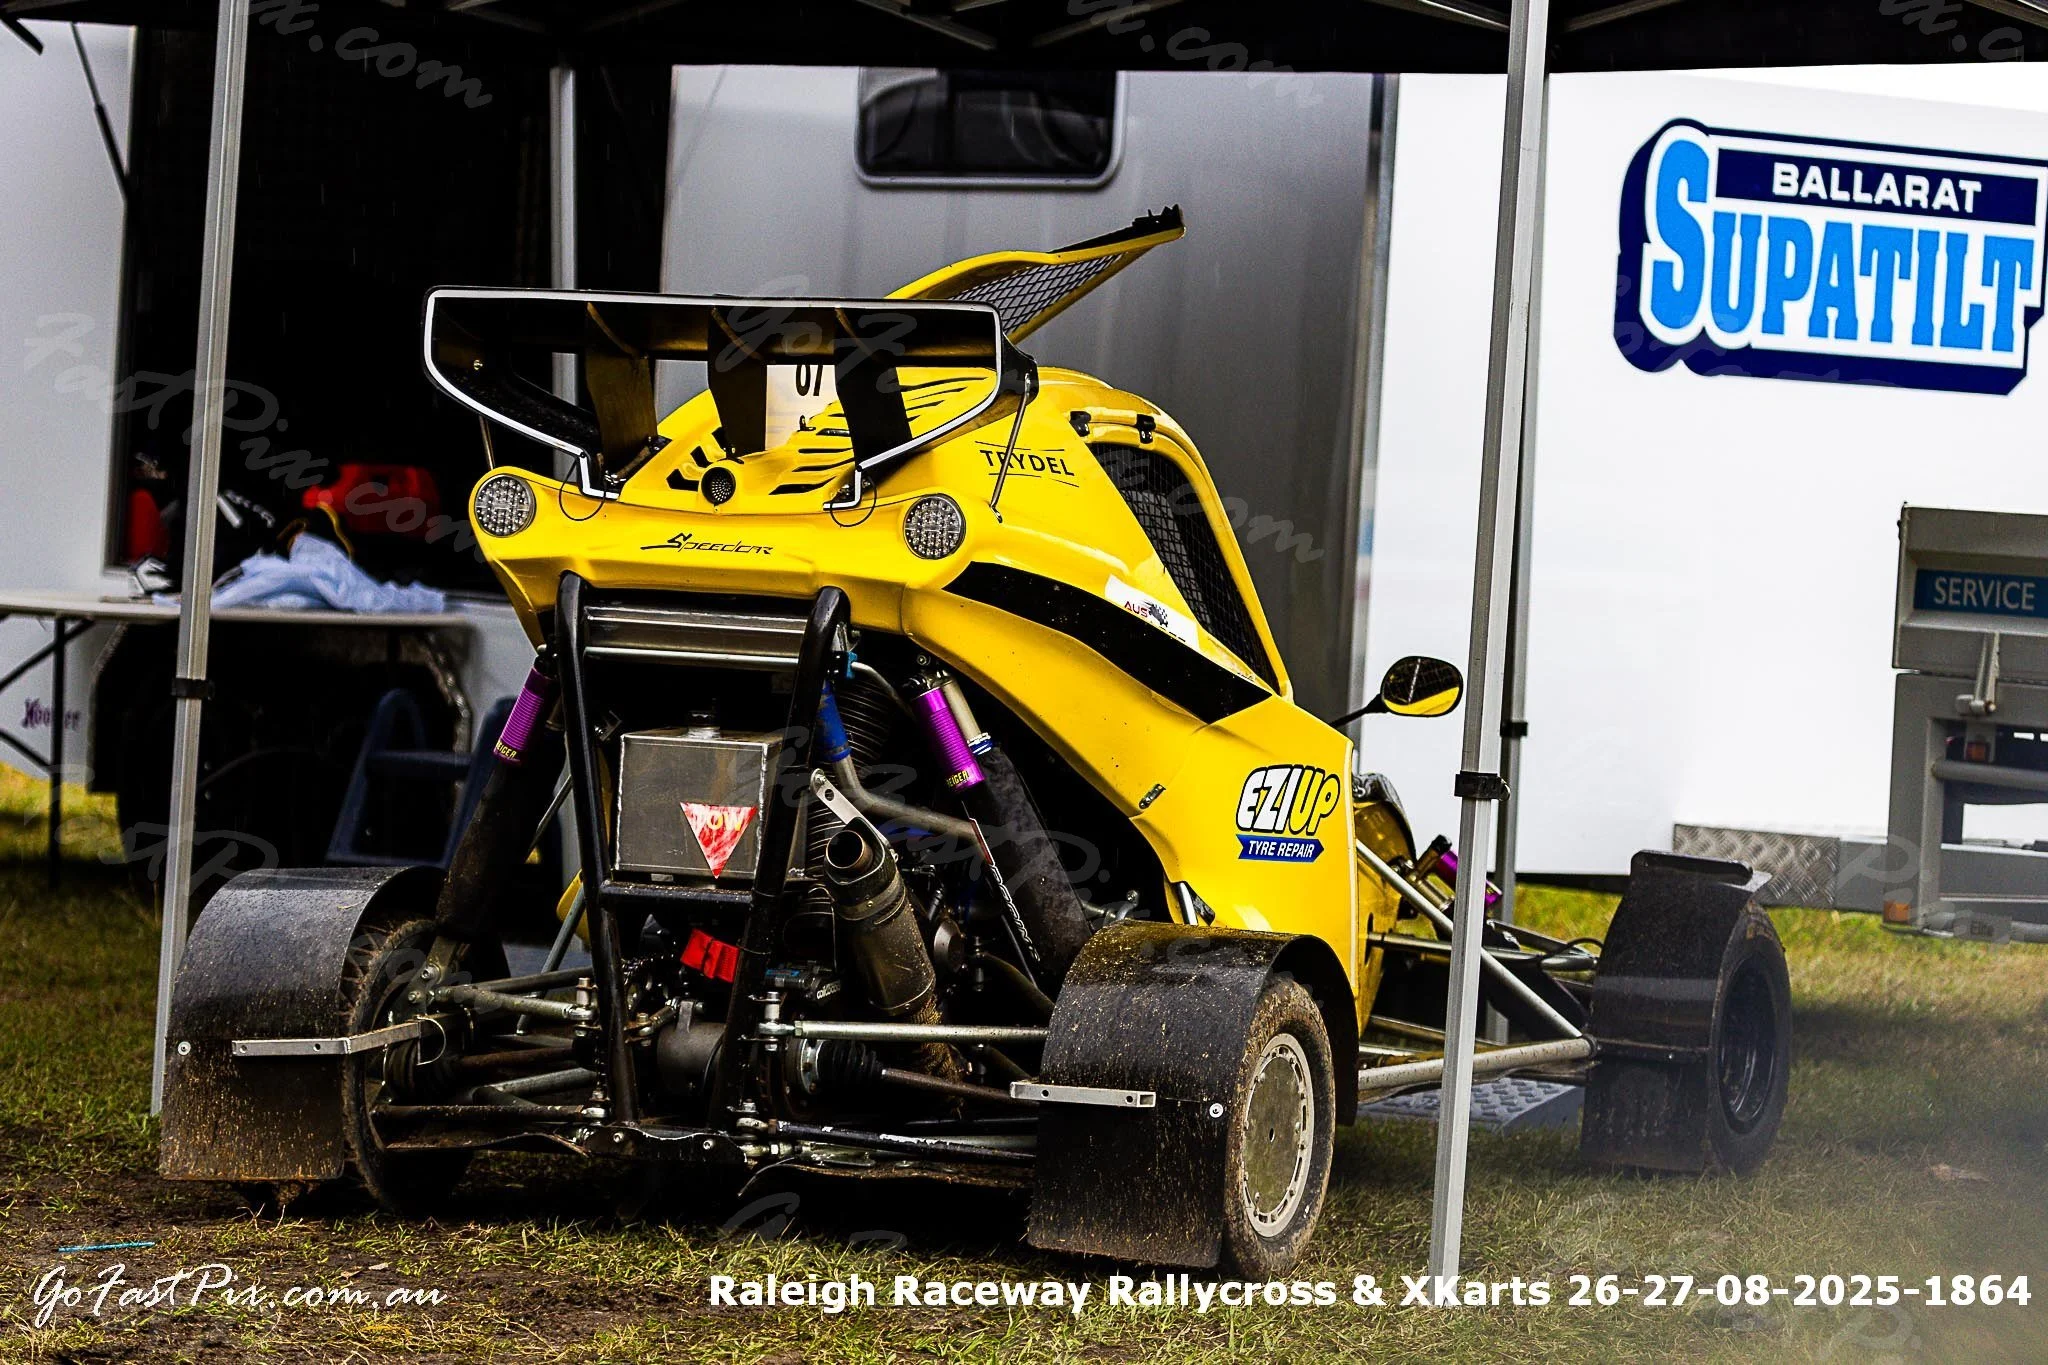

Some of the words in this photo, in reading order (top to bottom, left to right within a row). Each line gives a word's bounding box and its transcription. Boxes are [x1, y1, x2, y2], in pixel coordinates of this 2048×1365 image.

[1772, 161, 1982, 213] BALLARAT
[1650, 139, 2036, 354] SUPATILT
[978, 448, 1076, 477] TRYDEL
[1123, 600, 1149, 618] AUS
[1933, 575, 2036, 611] SERVICE
[1248, 840, 1278, 857] TYRE
[1276, 841, 1316, 858] REPAIR
